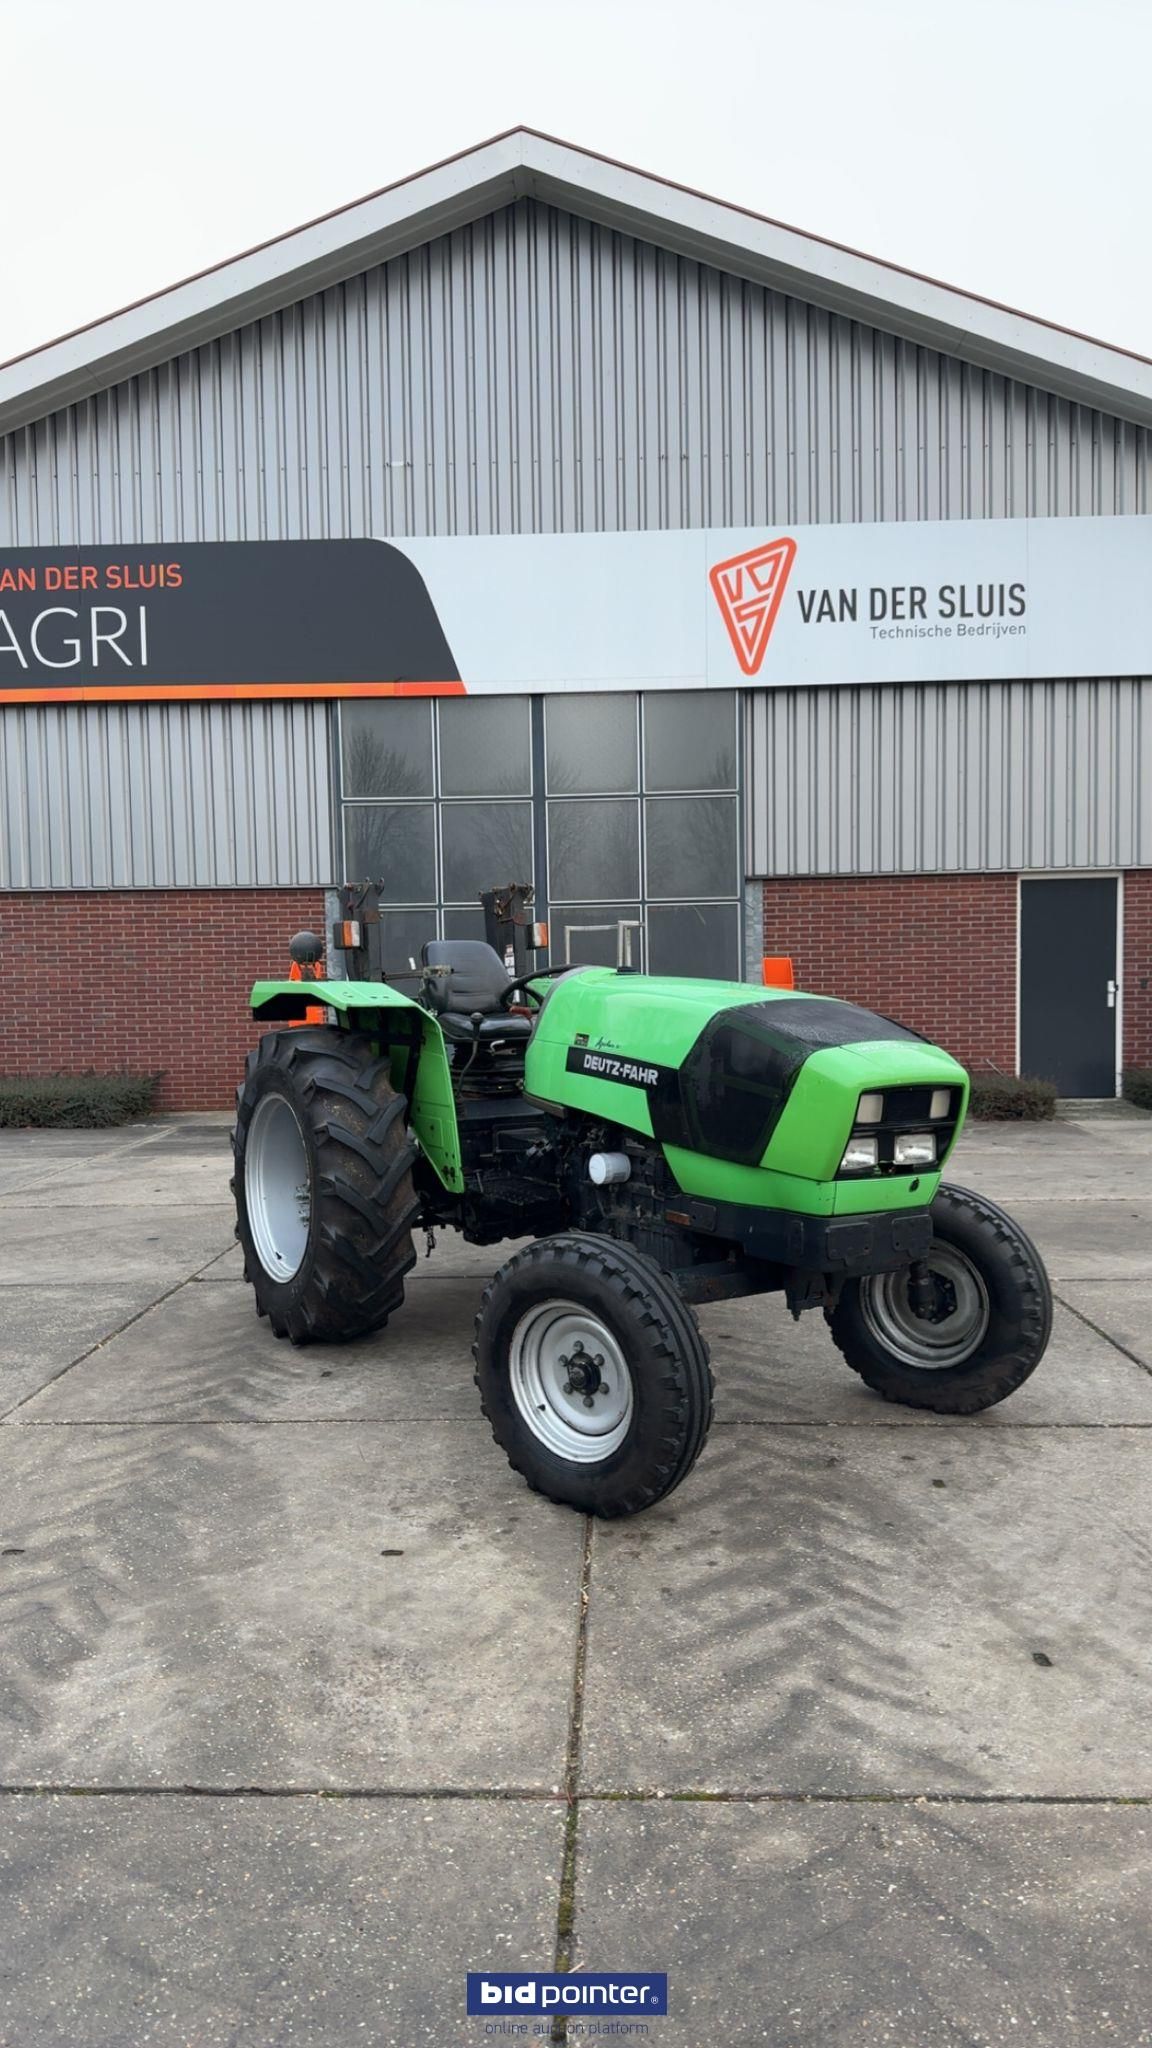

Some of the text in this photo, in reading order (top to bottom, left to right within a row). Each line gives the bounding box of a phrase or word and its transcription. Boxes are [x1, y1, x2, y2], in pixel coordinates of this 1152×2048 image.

[45, 566, 98, 591] DER
[106, 563, 183, 589] SLUIS
[797, 583, 1026, 623] VAN DER SLUIS
[870, 623, 1026, 640] Technische Bedrijven
[583, 1054, 659, 1086] DEUTZ-FAHR
